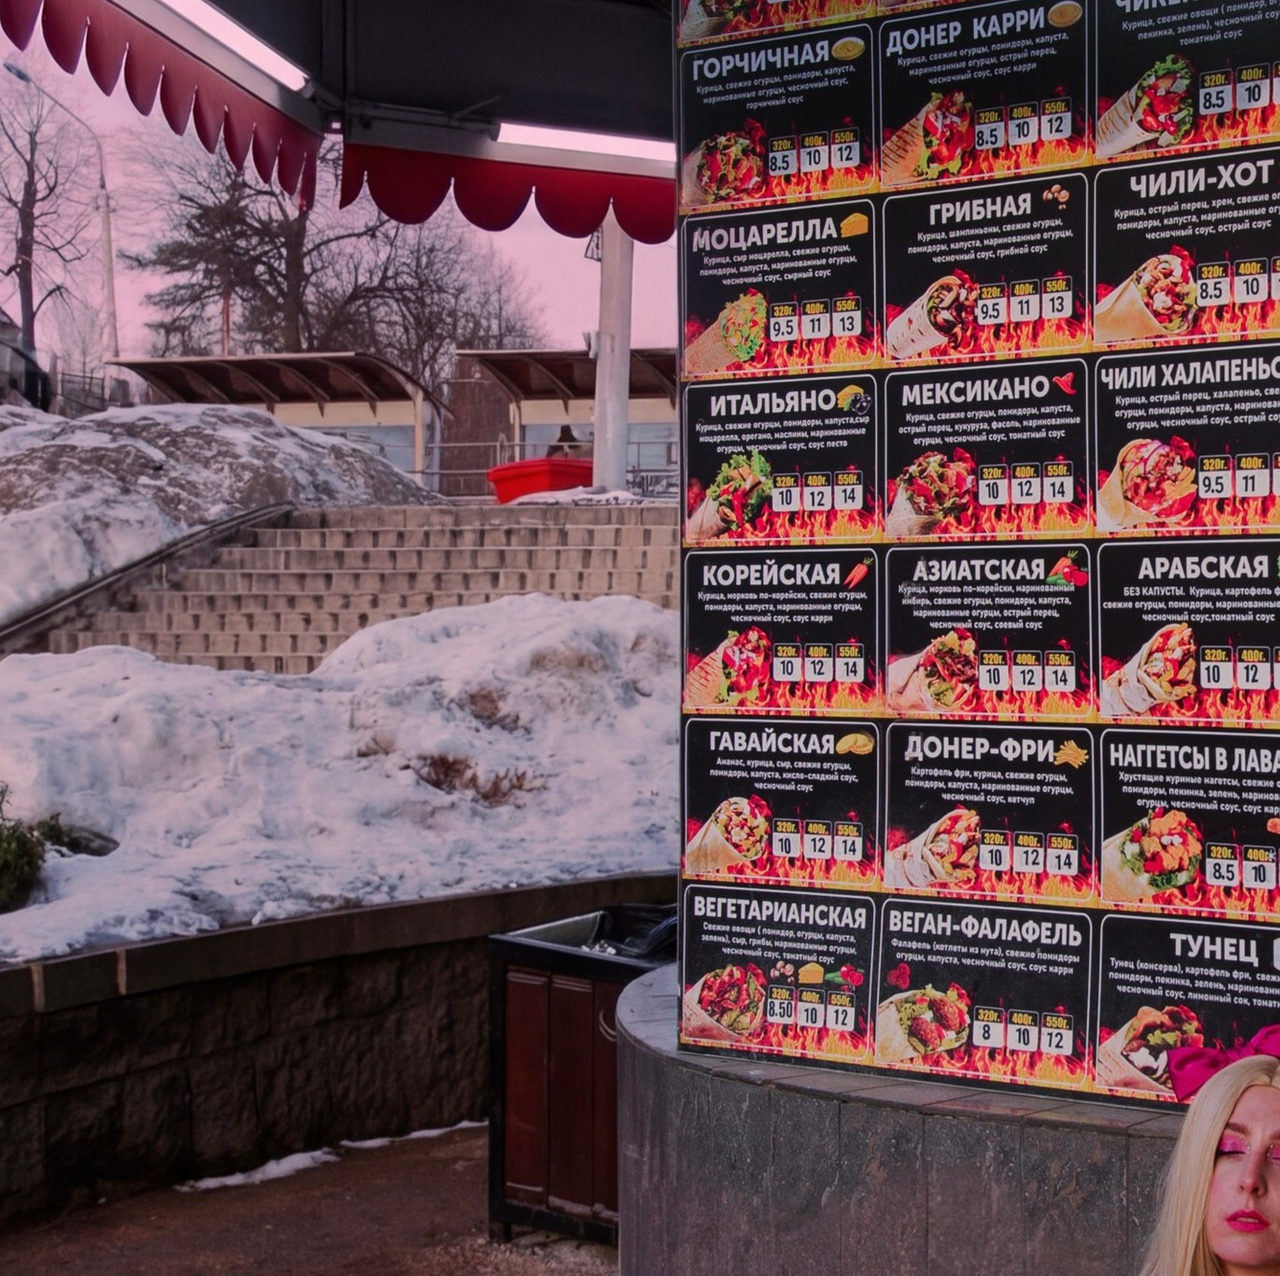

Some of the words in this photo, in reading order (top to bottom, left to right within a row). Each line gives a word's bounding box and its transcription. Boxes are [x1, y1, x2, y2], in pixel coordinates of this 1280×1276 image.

[886, 21, 961, 57] ДОНЕР
[973, 6, 1044, 39] КАРРИ
[693, 39, 833, 80] ГОРЧИЧНАЯ
[1130, 158, 1274, 198] ЧИЛИ-ХОТ
[929, 192, 1031, 225] ГРИБНАЯ
[692, 217, 838, 252] МОЦАРЕЛЛА
[773, 320, 794, 338] 9.5
[809, 316, 823, 334] 11
[838, 315, 855, 333] 13
[902, 375, 1054, 406] МЕКСИКАНО
[1100, 365, 1155, 390] ЧИЛИ
[710, 388, 840, 416] ИТАЛЬЯНО
[703, 559, 840, 586] КОРЕЙСКАЯ
[912, 558, 1049, 582] АЗИАТСКАЯ
[1138, 555, 1268, 579] АРАБСКАЯ
[1123, 586, 1140, 596] БЕЗ
[1141, 586, 1185, 596] КАПУСТЫ.
[1189, 586, 1223, 597] Курица,
[1224, 586, 1272, 597] картофель
[1204, 650, 1229, 661] 320г.
[1241, 650, 1266, 661] 400г.
[1205, 665, 1220, 683] 10
[1244, 664, 1258, 683] 12
[710, 727, 838, 754] ГАВАЙСКАЯ
[904, 735, 1058, 765] ДОНЕР-ФРИ
[1109, 743, 1210, 770] НАГГЕТСЫ
[1215, 747, 1227, 770] В
[911, 766, 953, 777] Картофель
[953, 768, 972, 779] фри,
[973, 770, 1004, 779] курица,
[1004, 771, 1035, 780] свежие
[1036, 773, 1068, 782] огурцы,
[694, 895, 866, 929] ВЕГЕТАРИАНСКАЯ
[889, 909, 1082, 946] ВЕГАН-ФАЛАФЕЛЬ
[1169, 932, 1259, 967] ТУНЕЦ
[768, 998, 793, 1019] 8.50
